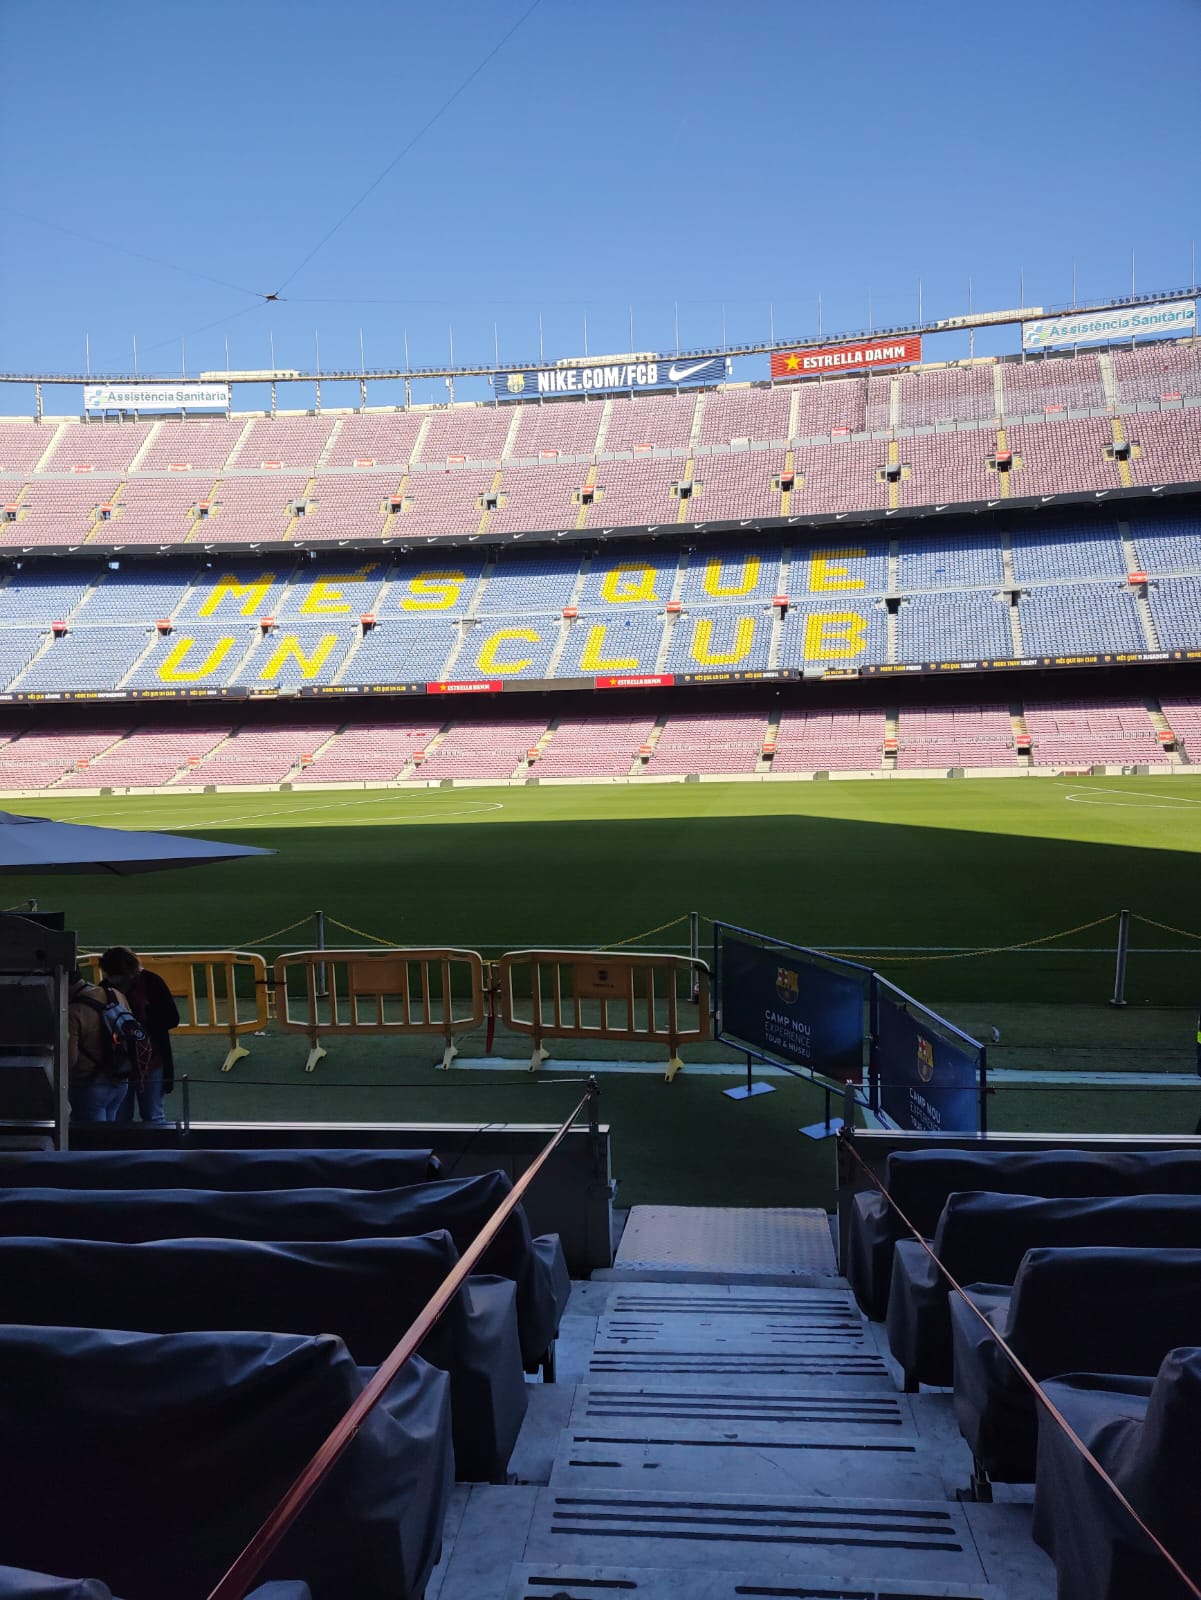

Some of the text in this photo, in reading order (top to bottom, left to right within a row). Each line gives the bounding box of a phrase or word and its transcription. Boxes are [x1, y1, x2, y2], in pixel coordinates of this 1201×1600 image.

[1050, 310, 1195, 337] Assistència Sanitària
[803, 345, 906, 370] ESTRELLA DAMM
[537, 363, 658, 392] NIKE.COM/FCB
[107, 390, 227, 403] Assistència Sanitària
[198, 549, 867, 617] MÉS QUE
[157, 611, 869, 682] UN CLUB
[764, 1021, 811, 1048] EXPERIENCE
[765, 1009, 811, 1036] CAMP NOU
[909, 1087, 941, 1124] CAMP NOU
